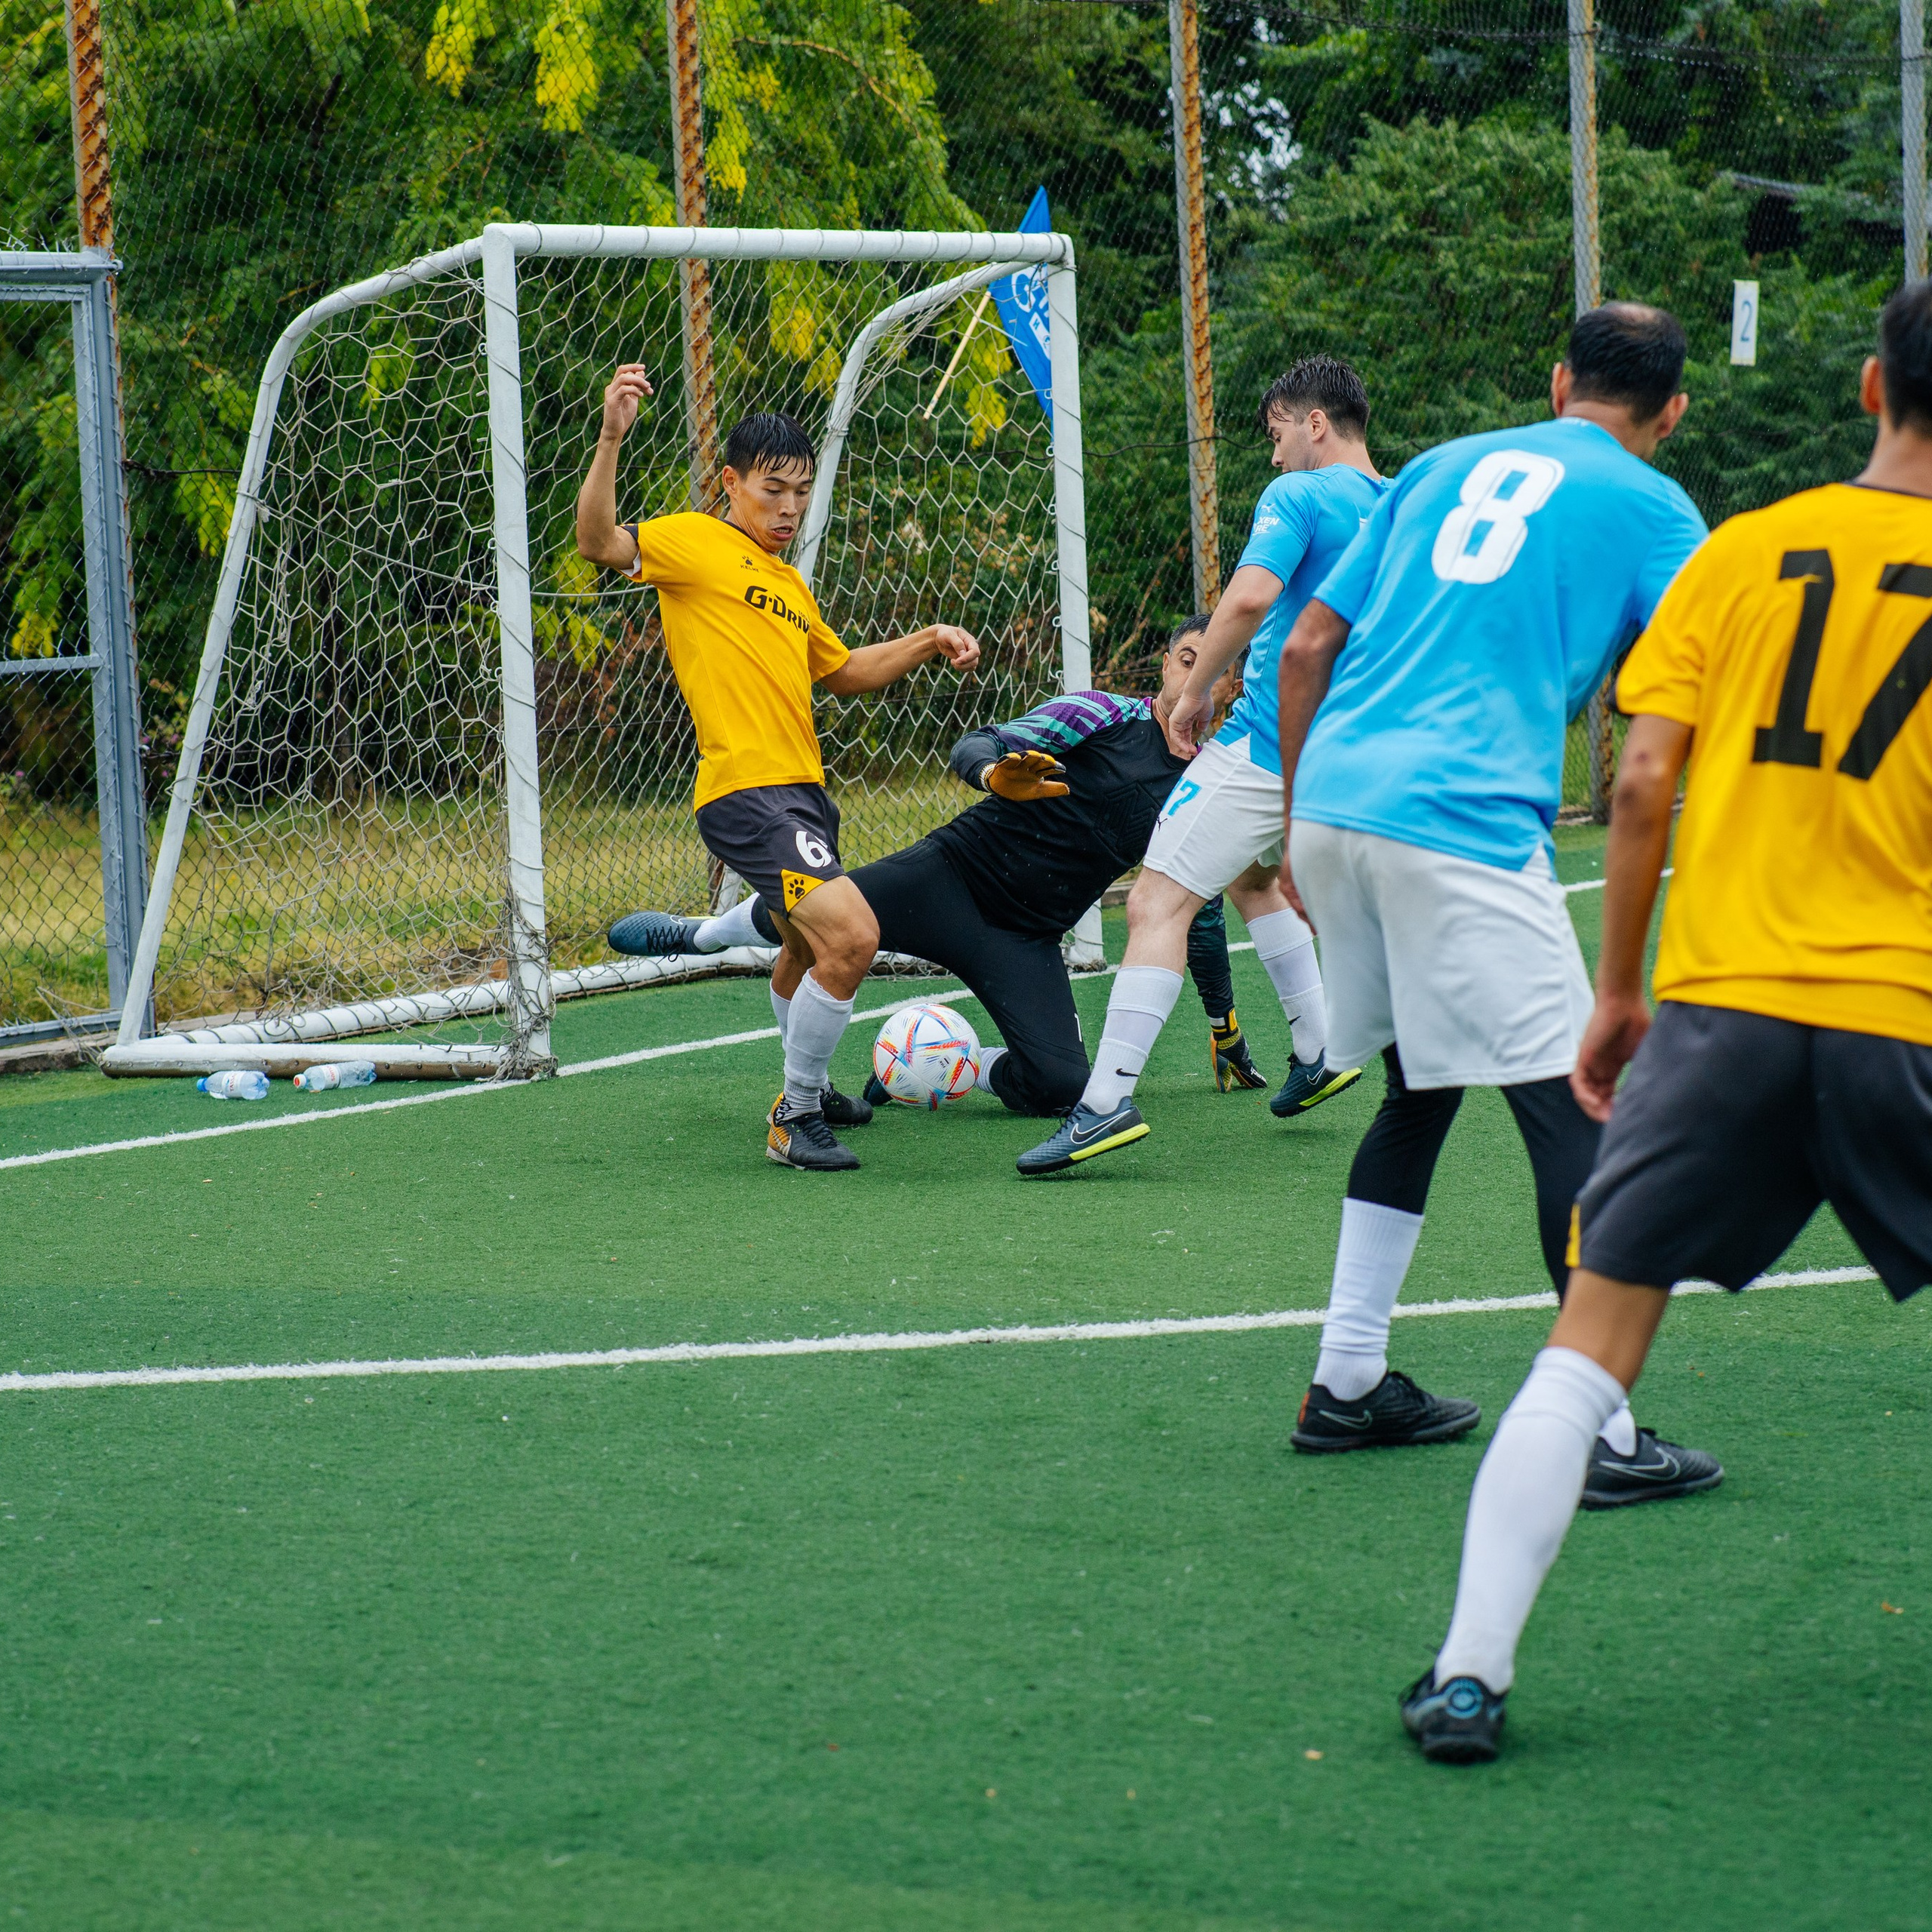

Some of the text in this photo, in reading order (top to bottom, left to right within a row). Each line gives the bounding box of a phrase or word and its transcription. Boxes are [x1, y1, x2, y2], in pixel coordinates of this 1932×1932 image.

[1740, 300, 1752, 342] 2
[1431, 448, 1565, 585] 8
[1751, 548, 1932, 782] 17
[795, 830, 832, 868] 6
